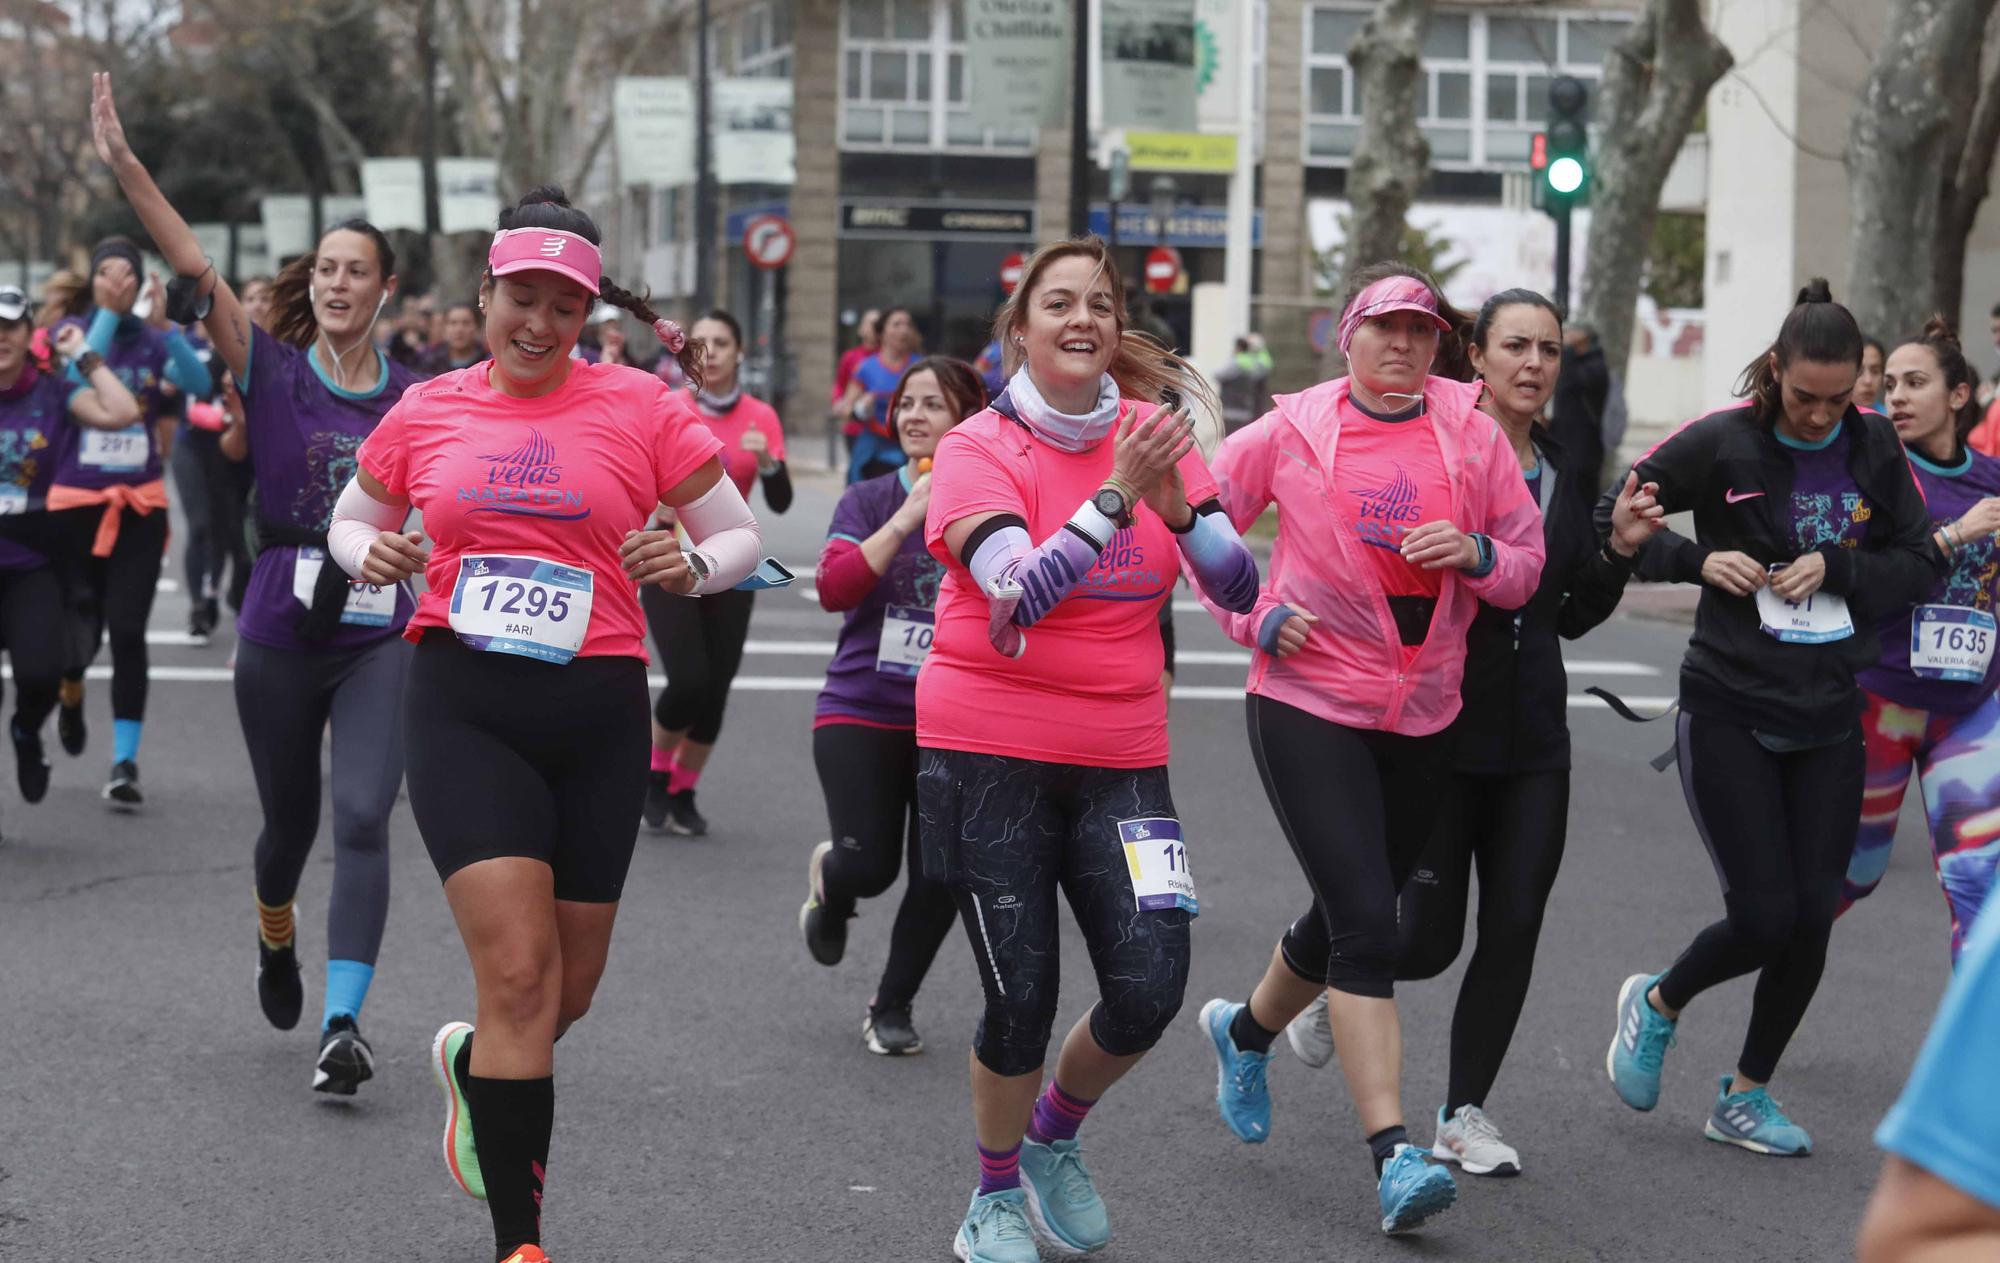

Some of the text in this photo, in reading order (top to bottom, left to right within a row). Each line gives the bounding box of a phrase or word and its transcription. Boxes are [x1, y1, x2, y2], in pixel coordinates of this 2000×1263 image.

[488, 464, 564, 489] velas
[456, 486, 584, 508] MARATON
[1360, 500, 1423, 525] velas
[1099, 545, 1144, 573] elas
[1078, 570, 1161, 586] ARATON
[480, 580, 571, 622] 1295
[505, 623, 533, 636] #ARI
[1792, 618, 1810, 627] Mara
[1933, 625, 1987, 654] 1635
